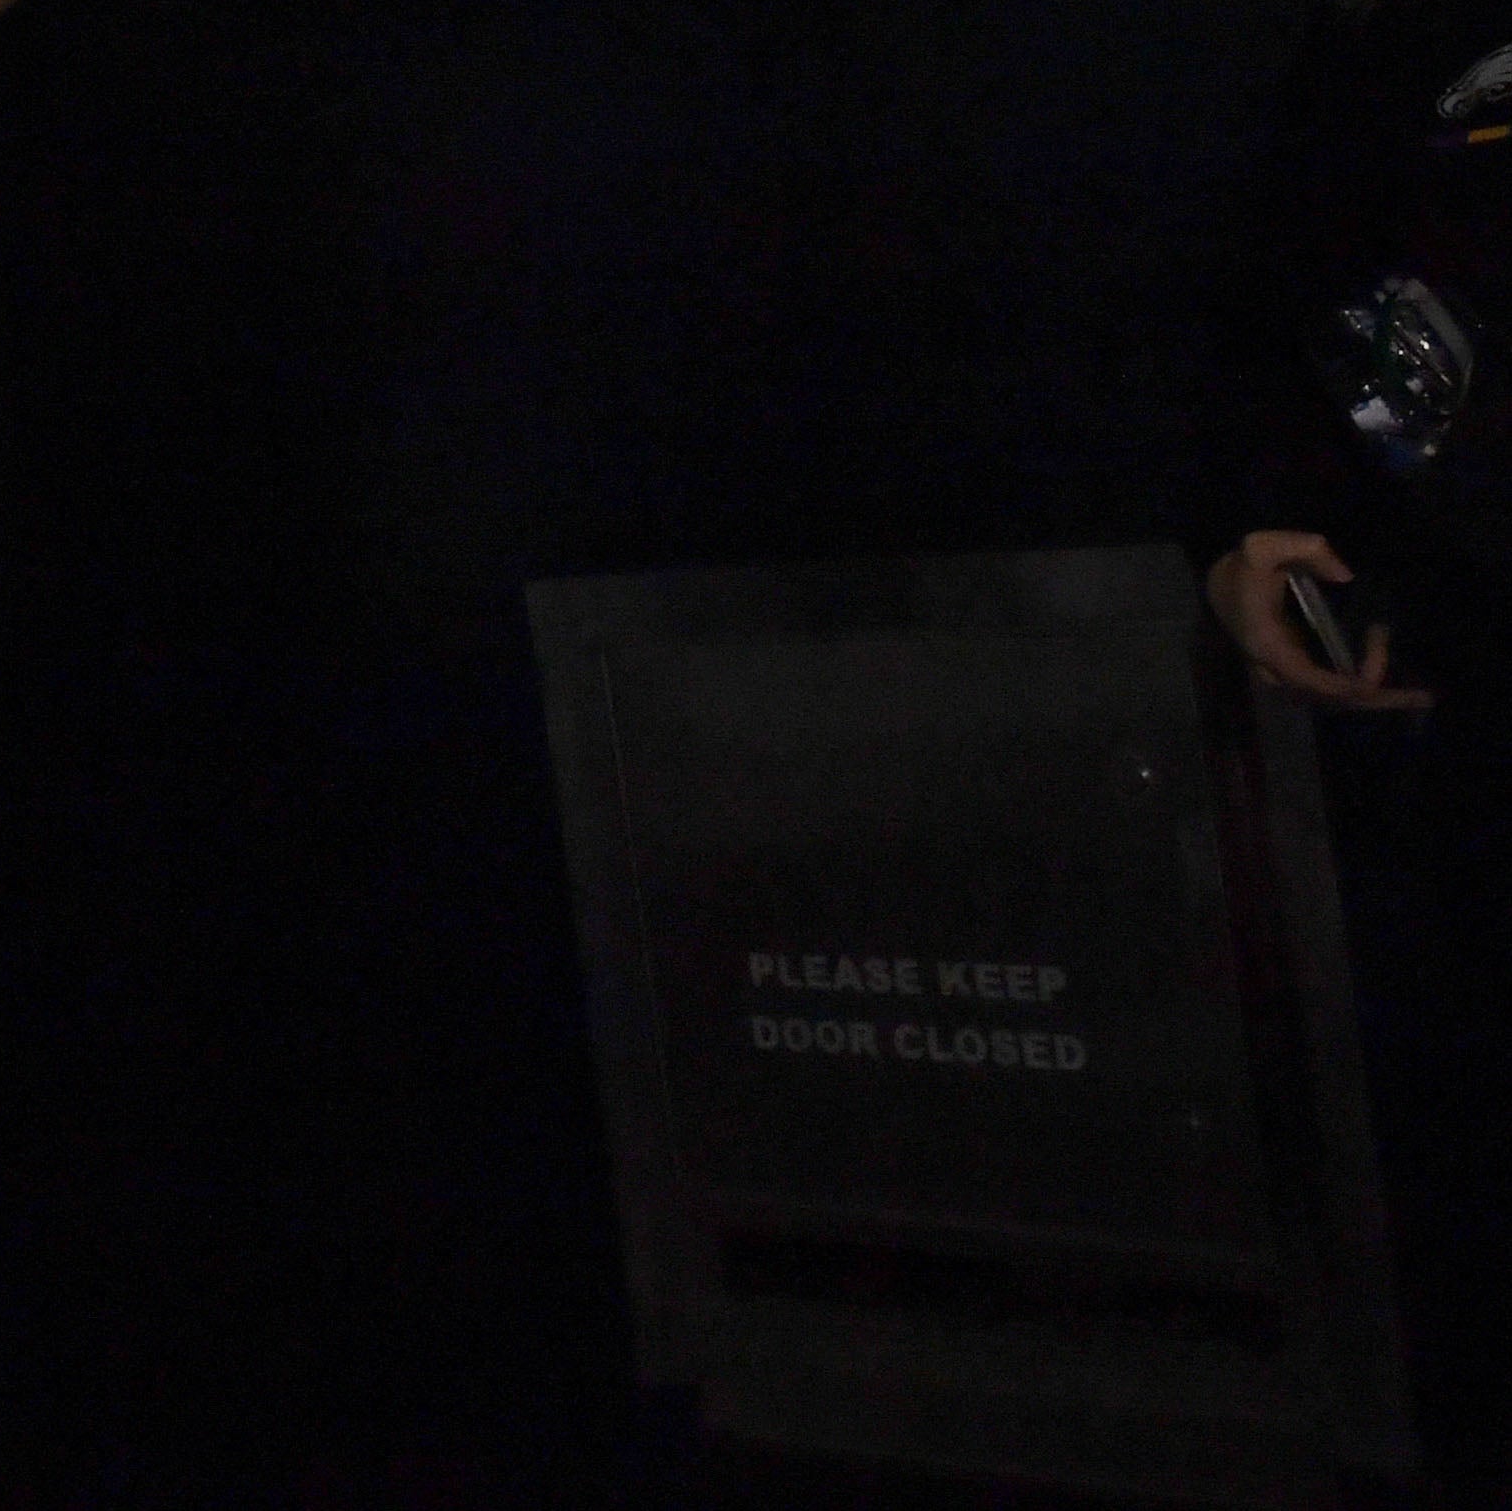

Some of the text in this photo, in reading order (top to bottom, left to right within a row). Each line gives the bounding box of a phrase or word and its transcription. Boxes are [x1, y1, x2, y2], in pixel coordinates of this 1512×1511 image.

[749, 953, 1067, 1001] PLEASE KEEP
[751, 1016, 1086, 1070] DOOR CLOSED
